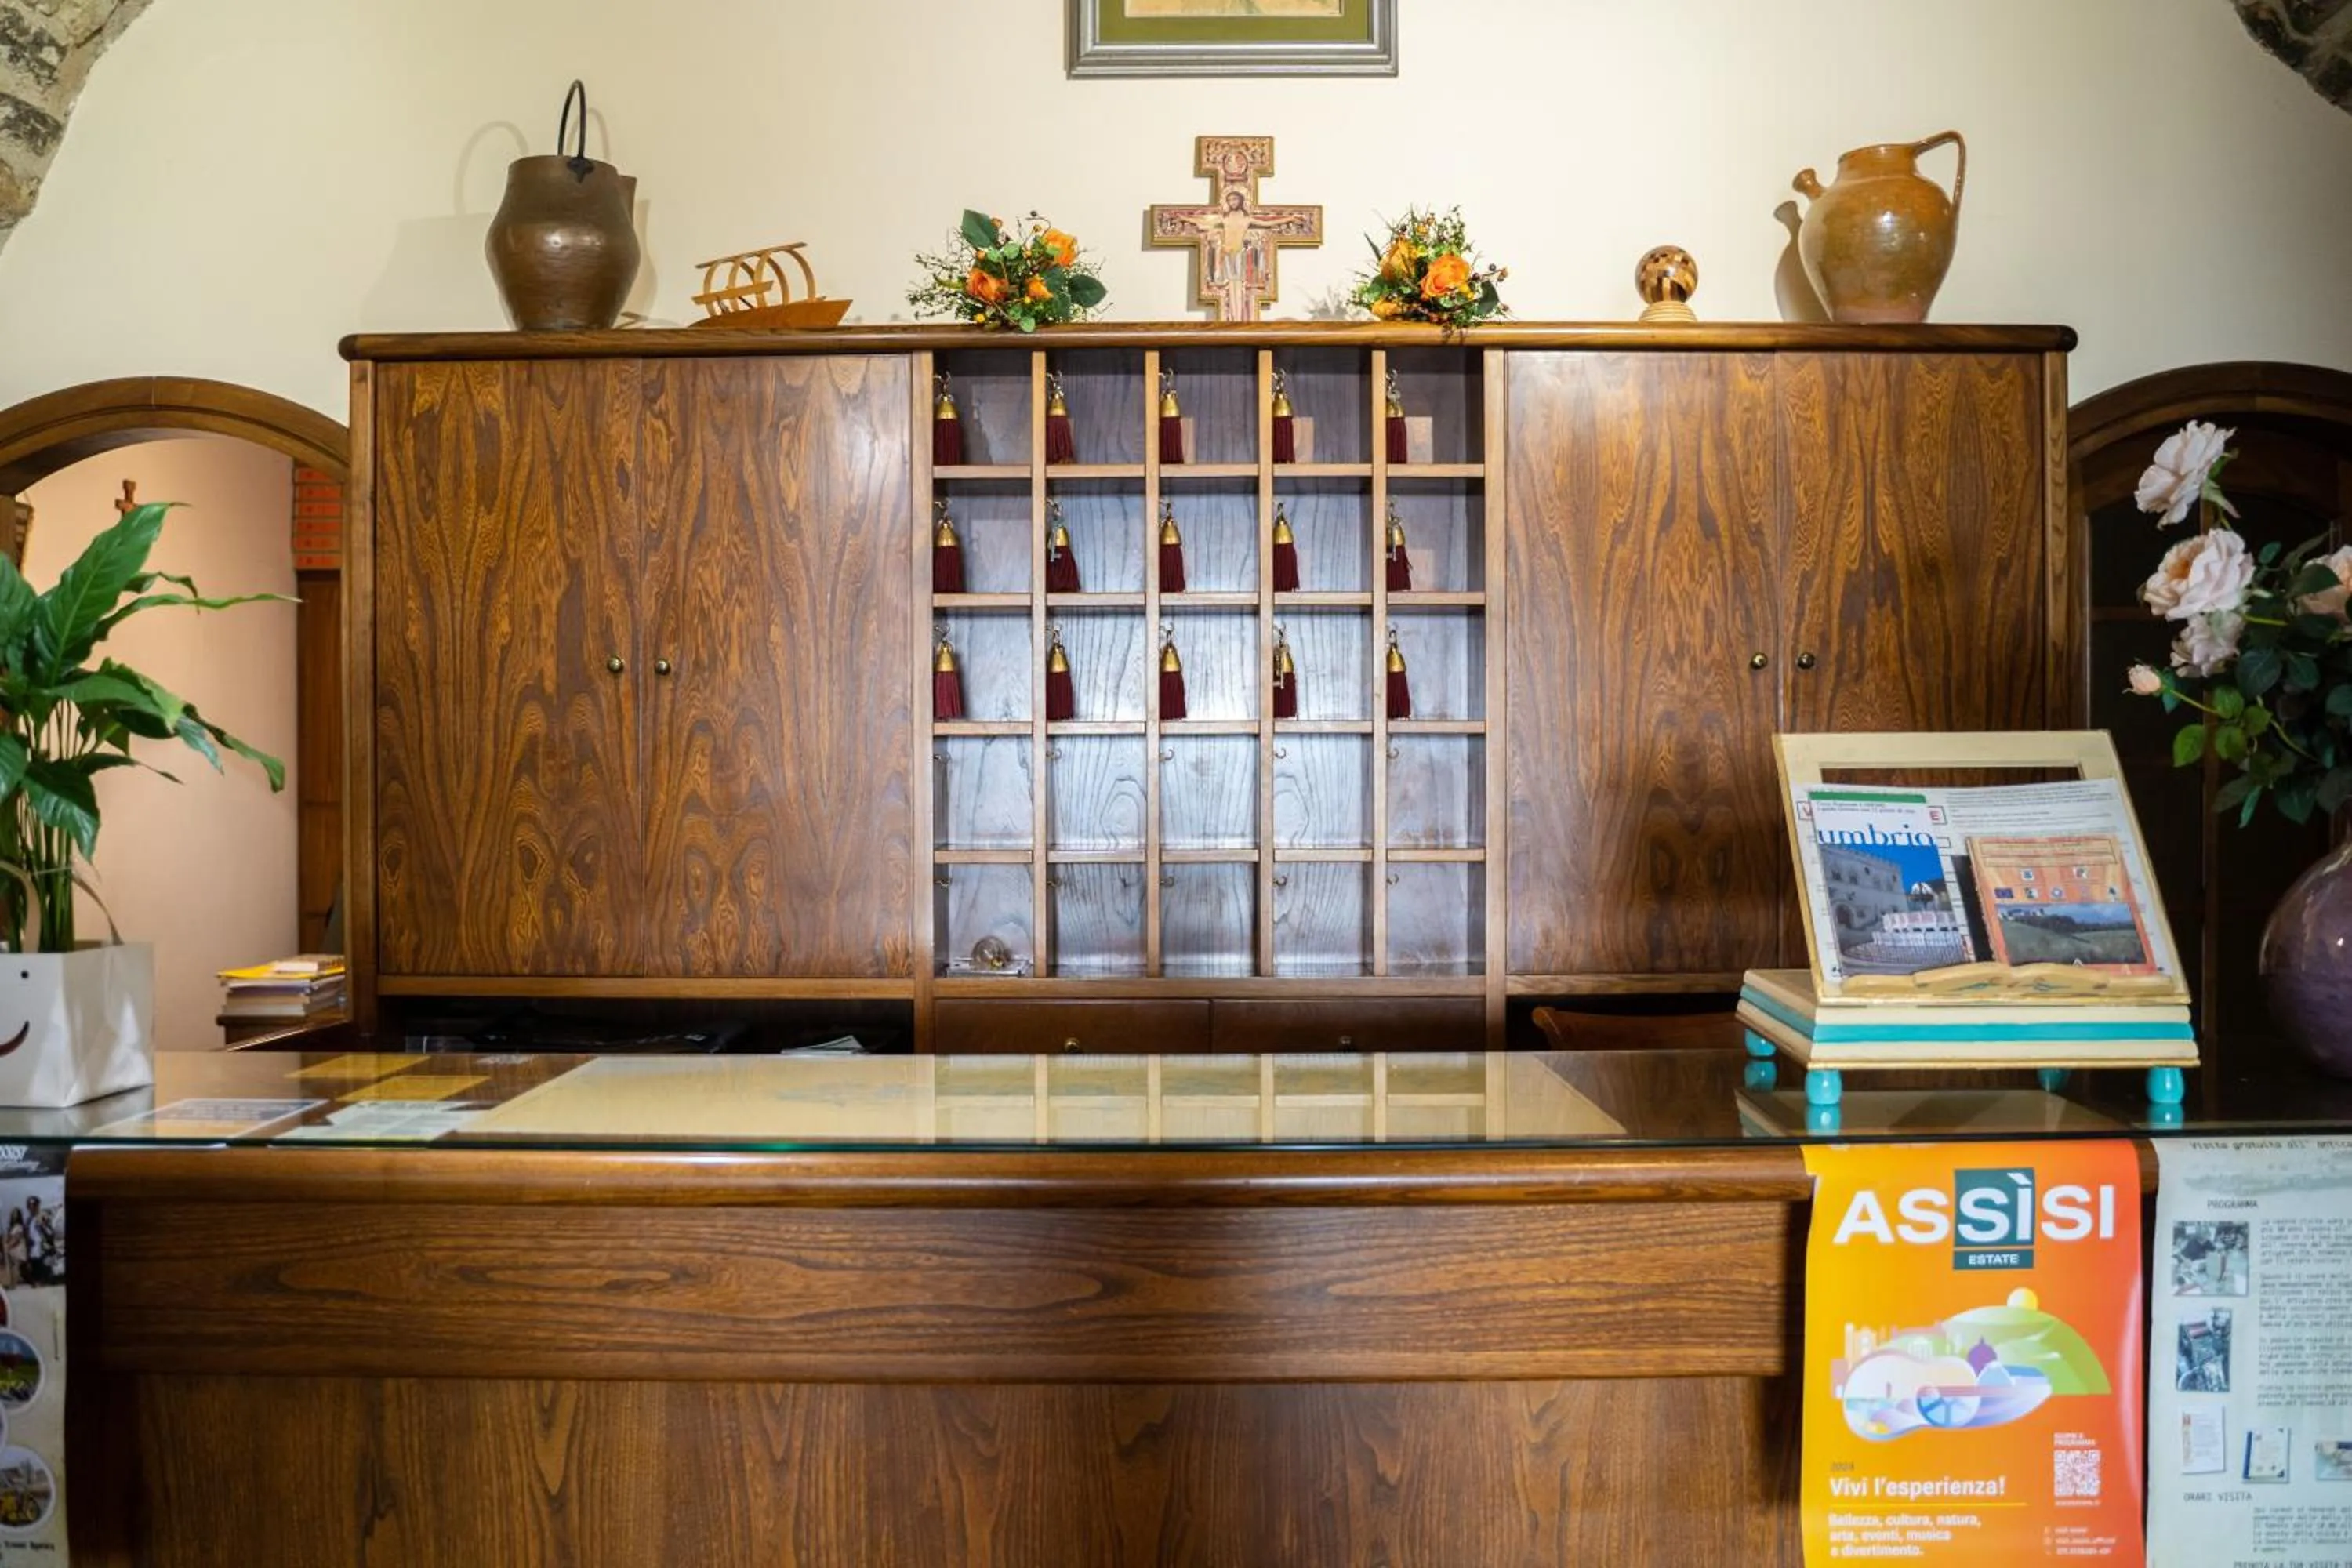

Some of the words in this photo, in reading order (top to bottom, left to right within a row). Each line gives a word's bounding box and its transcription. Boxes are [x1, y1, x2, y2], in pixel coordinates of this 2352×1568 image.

[1817, 824, 1937, 846] umbria
[1832, 1172, 2114, 1244] ASSÌSI
[1969, 1254, 2020, 1265] ESTATE
[1829, 1477, 1867, 1497] Vivi
[1875, 1475, 2006, 1501] l'esperienza!
[2218, 1492, 2252, 1502] VISITA
[1886, 1512, 1933, 1528] cultura,
[1936, 1514, 1982, 1528] natura,
[1861, 1529, 1904, 1544] eventi,
[1907, 1529, 1951, 1541] musica
[1842, 1544, 1924, 1557] divertimento.
